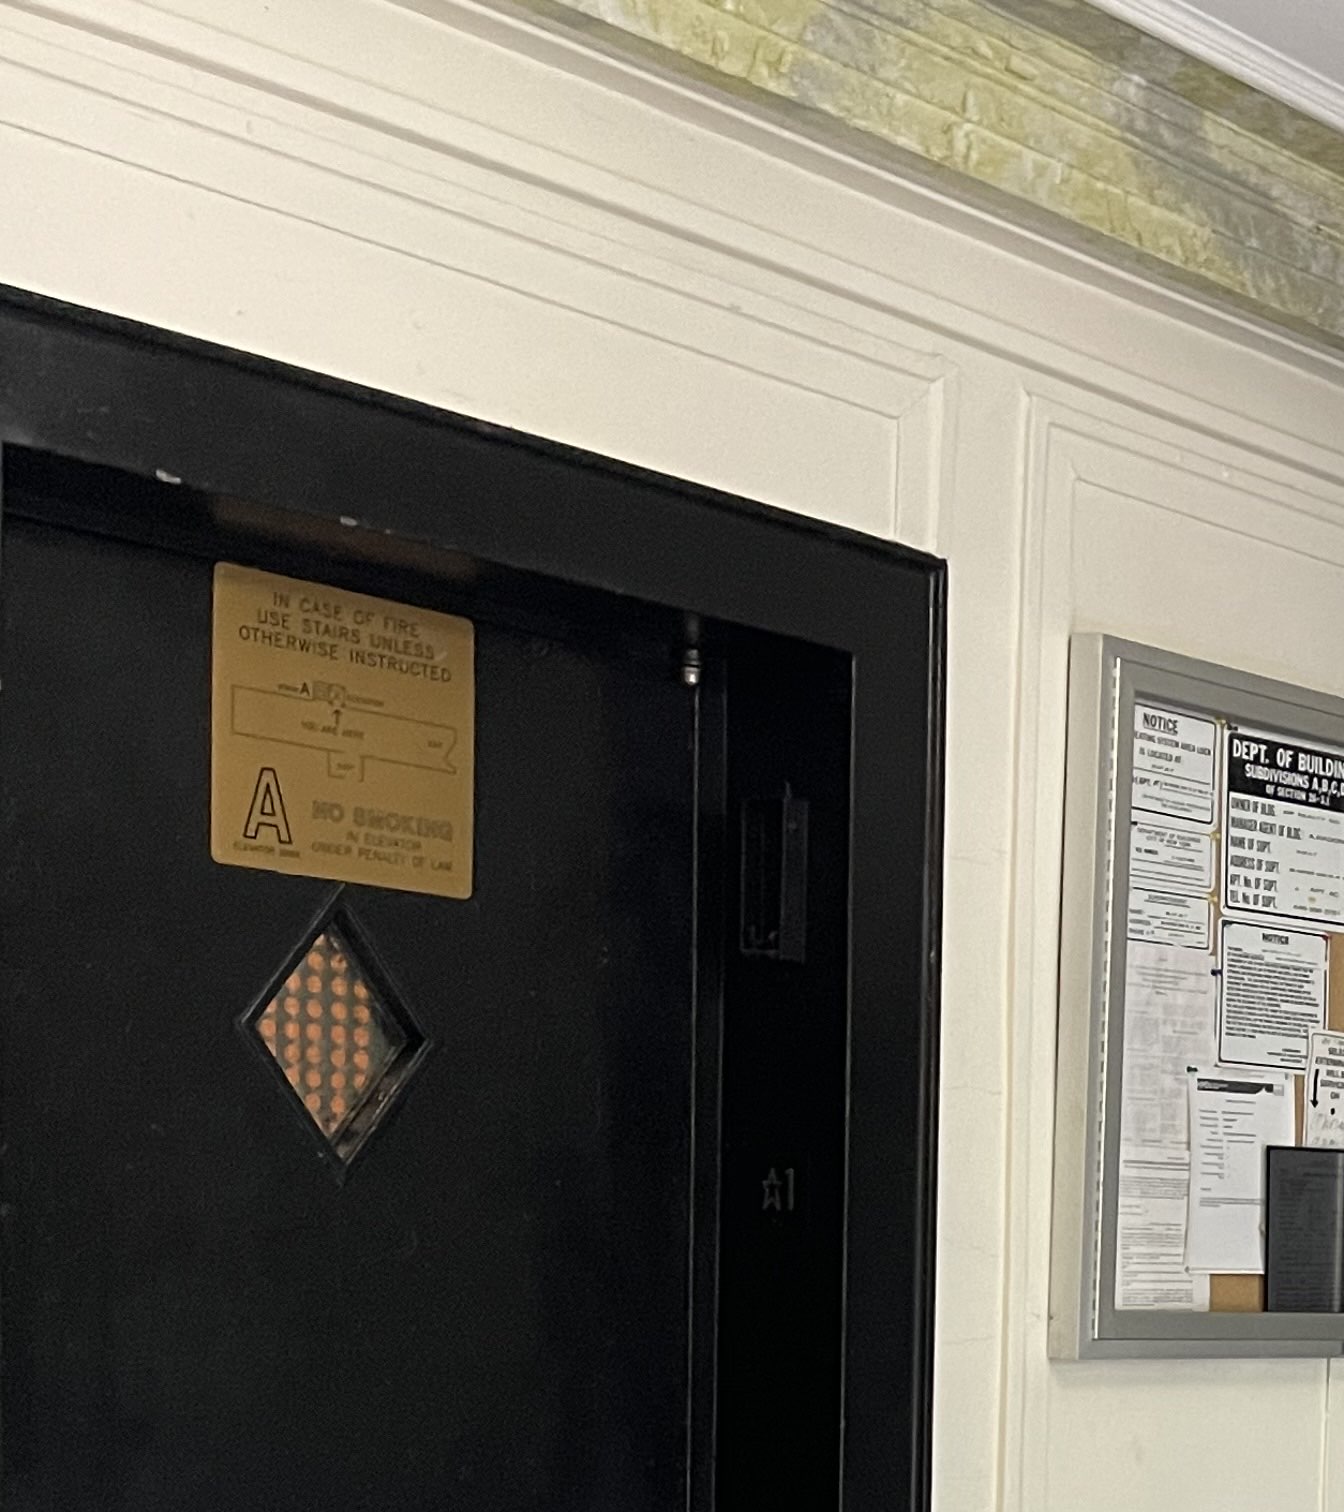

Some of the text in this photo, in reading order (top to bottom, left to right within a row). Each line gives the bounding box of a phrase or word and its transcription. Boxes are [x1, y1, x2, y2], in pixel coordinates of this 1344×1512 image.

[274, 592, 420, 638] IN CASE OF FIRE
[257, 608, 436, 660] USE STAIRS UNLESS
[239, 625, 452, 682] OTHERWISE INSTRUCTED
[1143, 712, 1178, 734] NOTICE
[1232, 738, 1270, 764] DEPT.
[1276, 748, 1294, 768] OF
[1244, 762, 1310, 789] SUBDIVISIONS
[1277, 786, 1306, 801] SECTION
[243, 767, 293, 844] A
[312, 800, 453, 842] NO SMOKING
[1262, 932, 1289, 945] NOTICE
